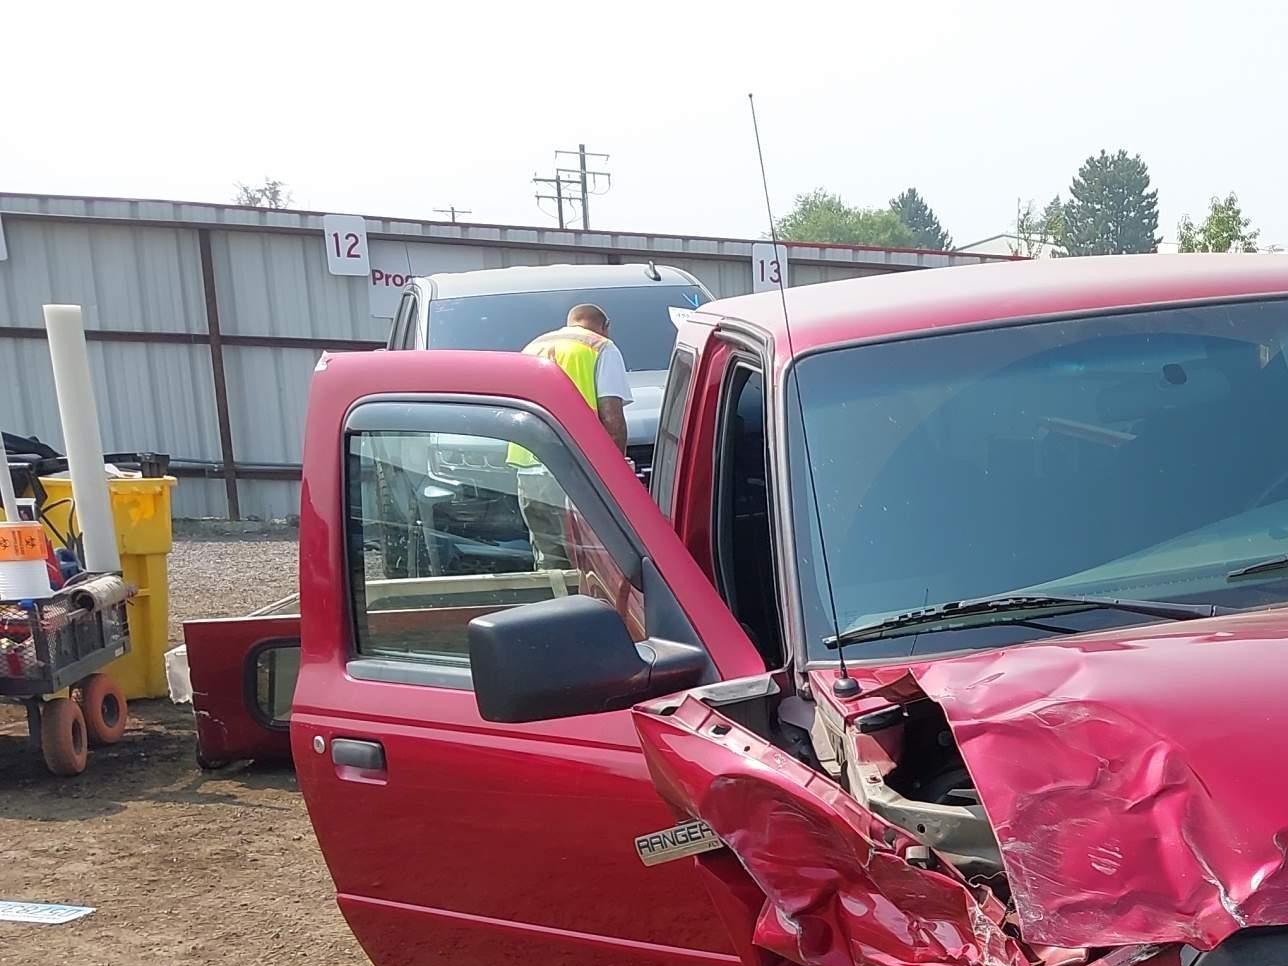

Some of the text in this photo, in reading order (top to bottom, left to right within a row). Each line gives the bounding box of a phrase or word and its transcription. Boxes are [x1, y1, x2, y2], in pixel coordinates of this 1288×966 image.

[332, 232, 361, 258] 12
[760, 259, 781, 283] 13
[637, 822, 715, 855] RANGER
